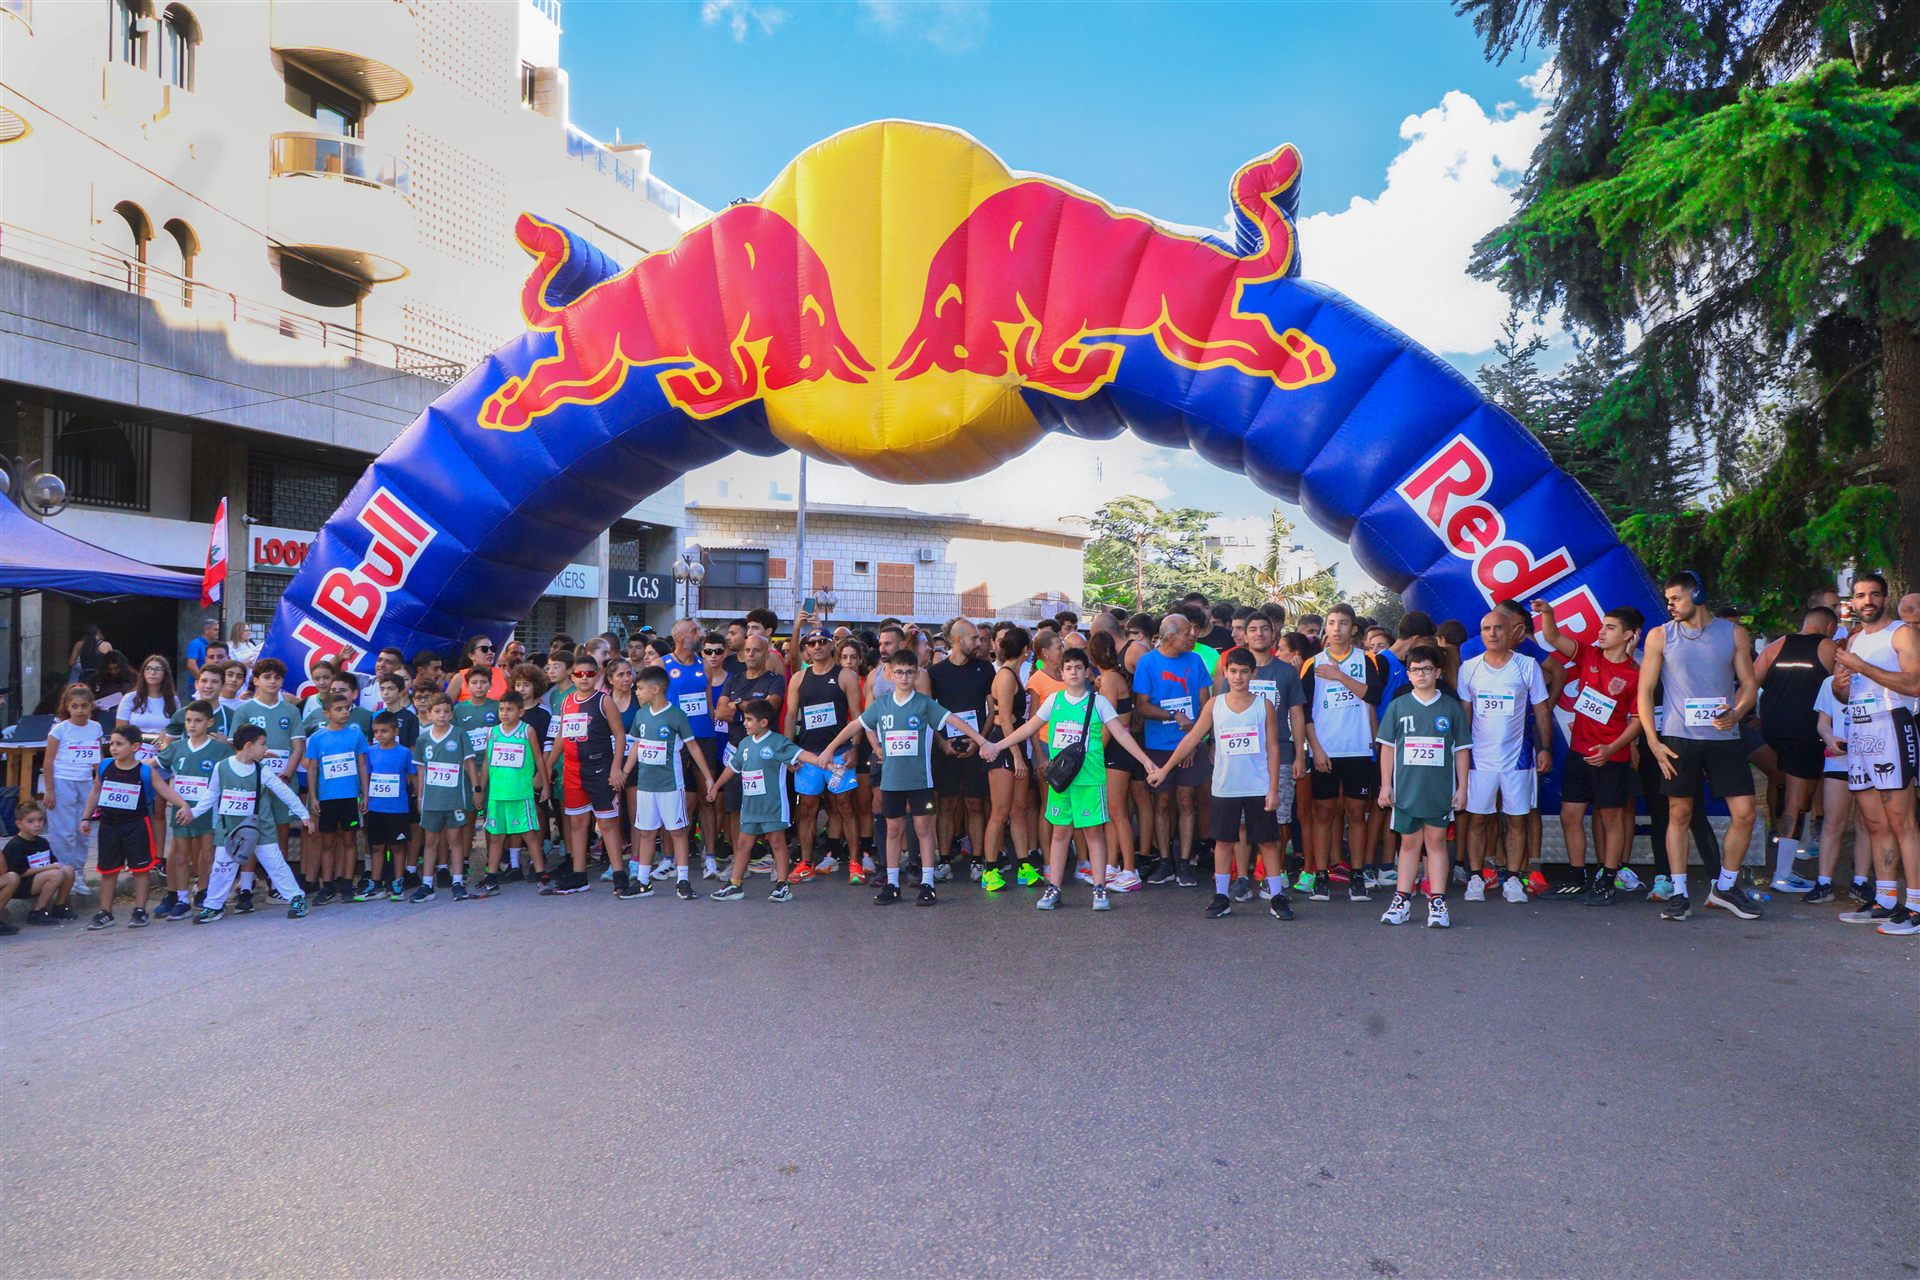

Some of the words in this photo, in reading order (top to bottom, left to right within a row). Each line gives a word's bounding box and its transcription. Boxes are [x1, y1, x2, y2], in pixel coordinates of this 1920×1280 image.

[1400, 437, 1572, 604] Red
[315, 491, 432, 637] Bull
[553, 571, 586, 589] KERS
[1350, 663, 1363, 677] 21
[1335, 691, 1354, 702] 255
[686, 702, 701, 712] 351
[1484, 700, 1504, 710] 391
[1582, 699, 1602, 715] 386
[1694, 710, 1717, 720] 424
[1852, 705, 1867, 716] 291
[811, 713, 828, 724] 287
[881, 714, 894, 730] 30
[565, 722, 580, 731] 740
[639, 723, 646, 738] 8
[471, 738, 486, 747] 257
[1061, 734, 1080, 743] 729
[1228, 738, 1250, 749] 679
[891, 741, 911, 750] 656
[75, 750, 94, 758] 739
[424, 745, 433, 759] 6
[498, 752, 516, 761] 738
[642, 750, 659, 759] 657
[1412, 748, 1435, 759] 725
[264, 760, 283, 768] 452
[330, 763, 349, 773] 455
[433, 772, 451, 781] 719
[180, 785, 198, 795] 654
[373, 784, 391, 793] 456
[108, 792, 130, 803] 680
[229, 801, 249, 811] 728
[454, 808, 465, 821] 6
